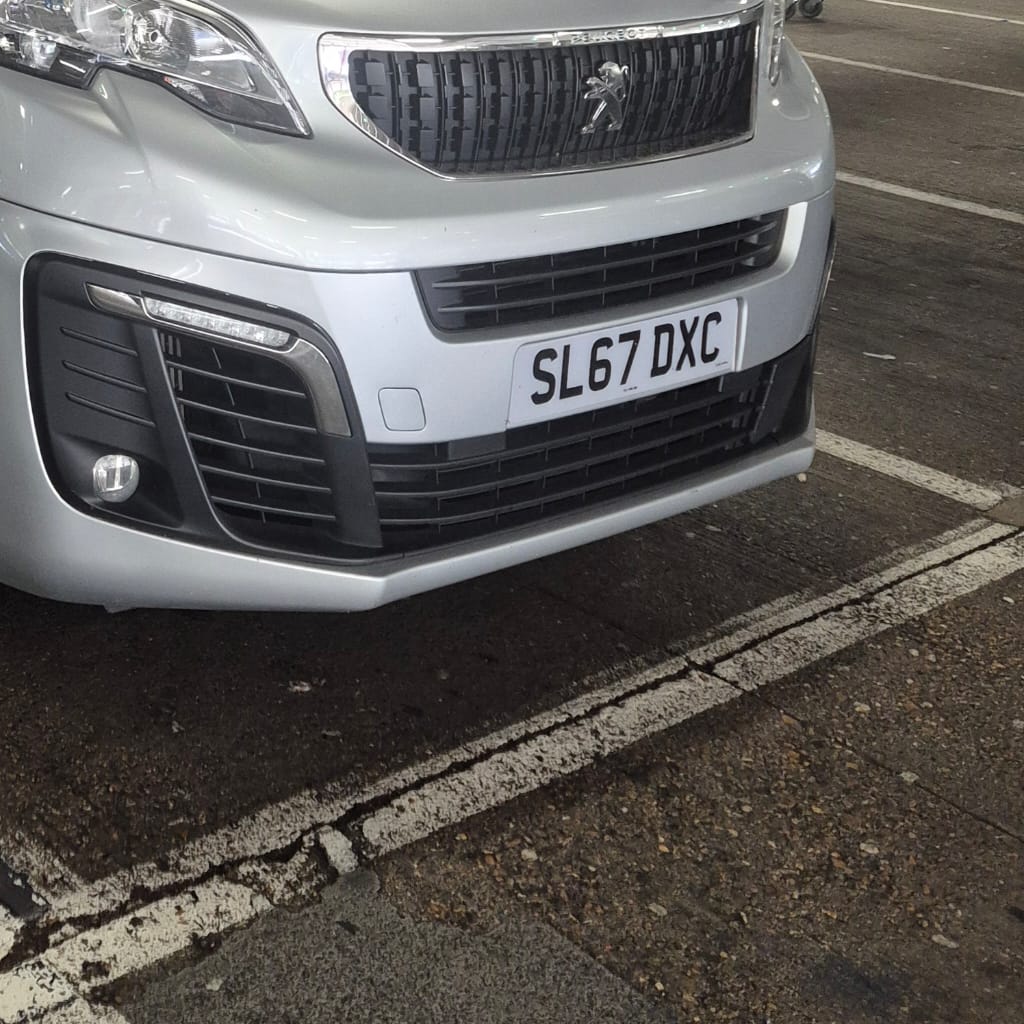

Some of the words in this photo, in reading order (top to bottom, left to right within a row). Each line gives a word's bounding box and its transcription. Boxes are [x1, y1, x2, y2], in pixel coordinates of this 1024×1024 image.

[571, 27, 645, 44] PEUGEOT
[530, 329, 641, 406] SL67
[650, 311, 722, 378] DXC
